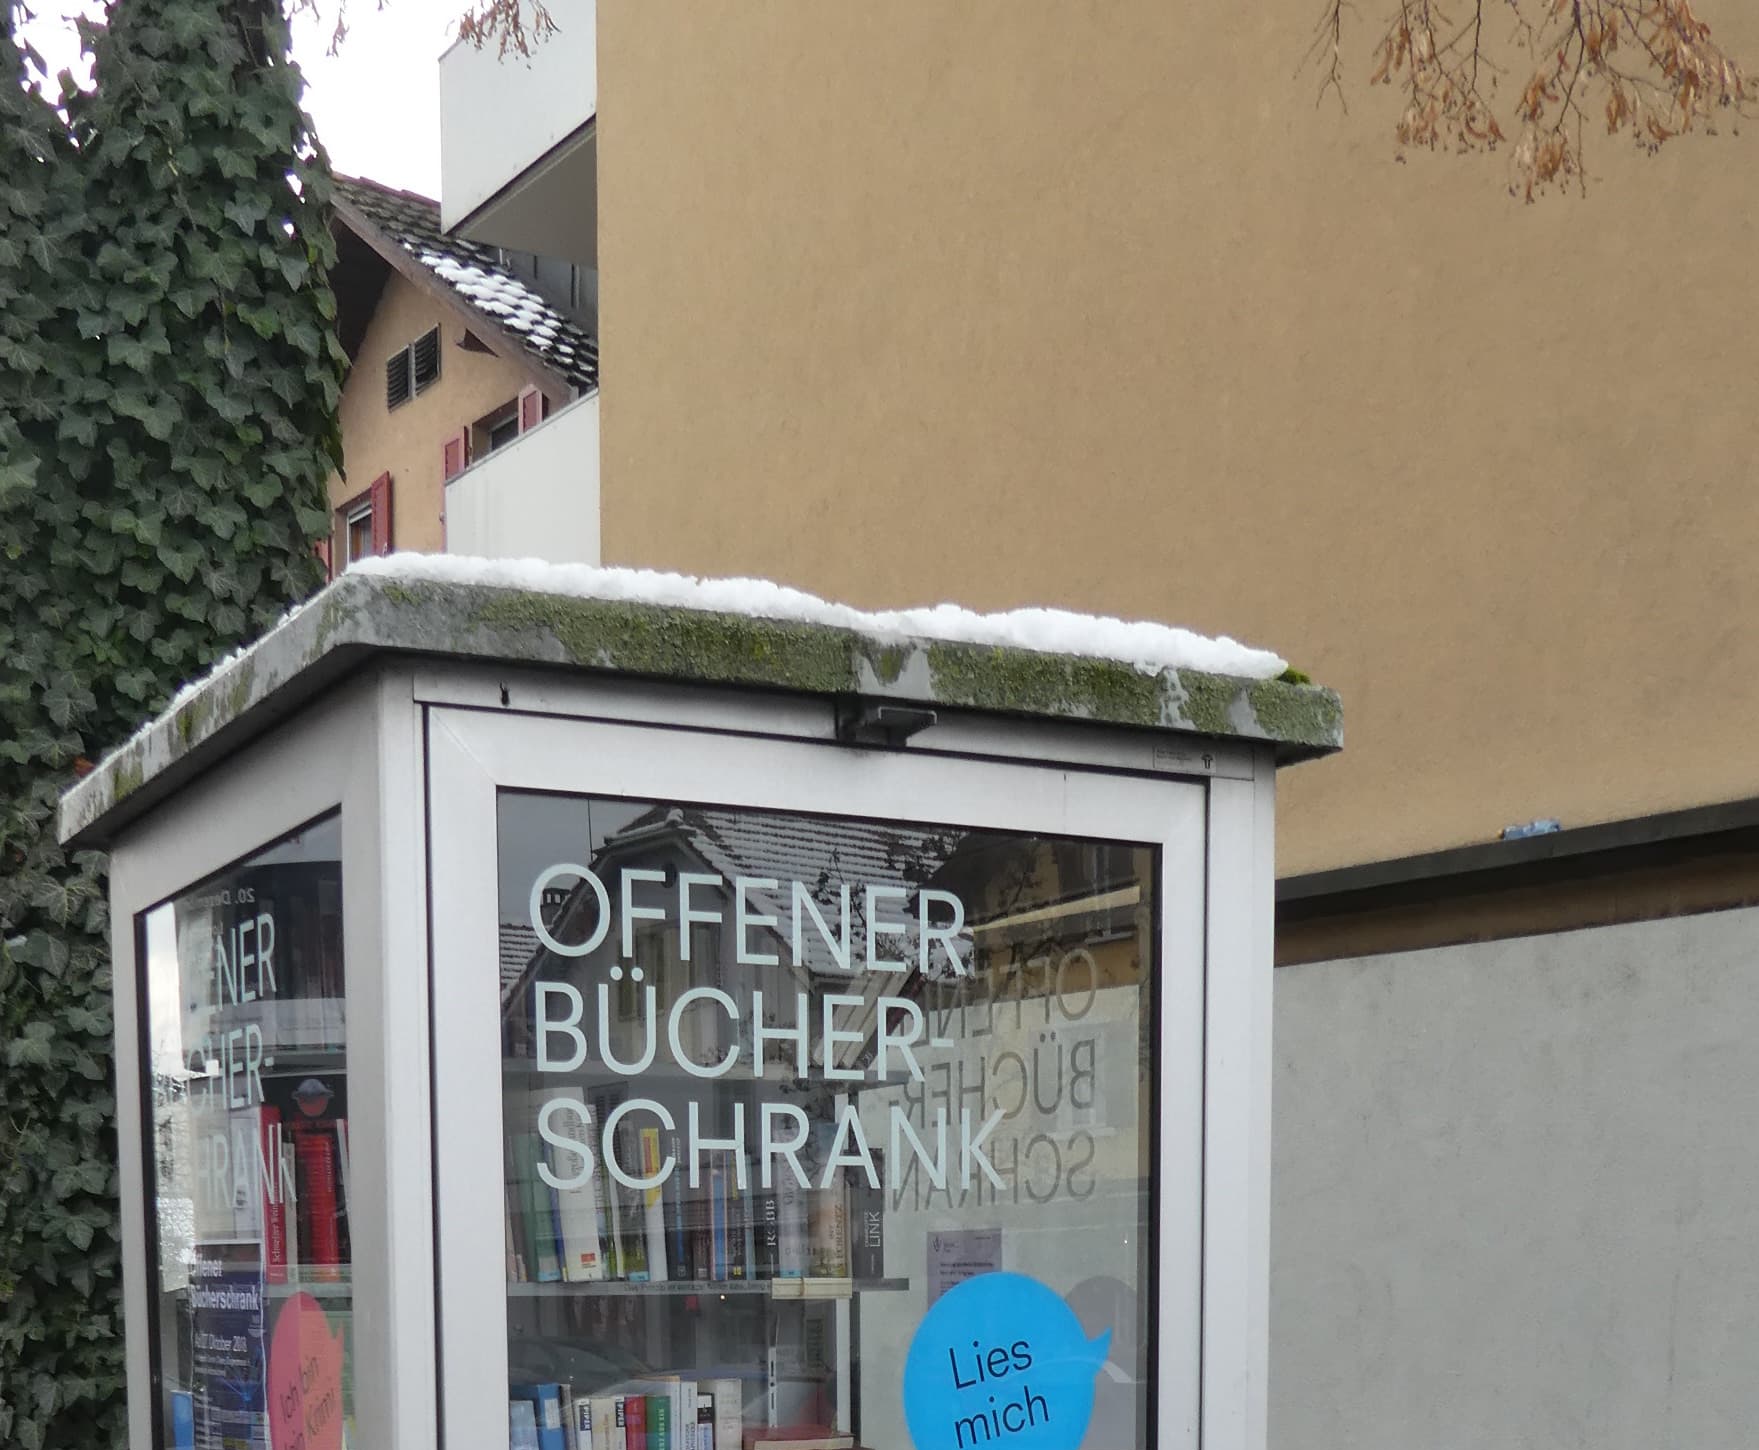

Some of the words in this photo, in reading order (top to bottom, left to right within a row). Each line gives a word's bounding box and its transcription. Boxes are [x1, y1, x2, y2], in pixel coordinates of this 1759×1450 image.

[529, 863, 966, 976] OFFENER
[534, 965, 954, 1083] BÜCHER-
[536, 1096, 1007, 1191] SCHRANK
[869, 1211, 881, 1248] LINK
[280, 1380, 299, 1424] Ich
[298, 1354, 321, 1396] bin
[948, 1339, 1034, 1391] Lies
[954, 1385, 1050, 1450] mich
